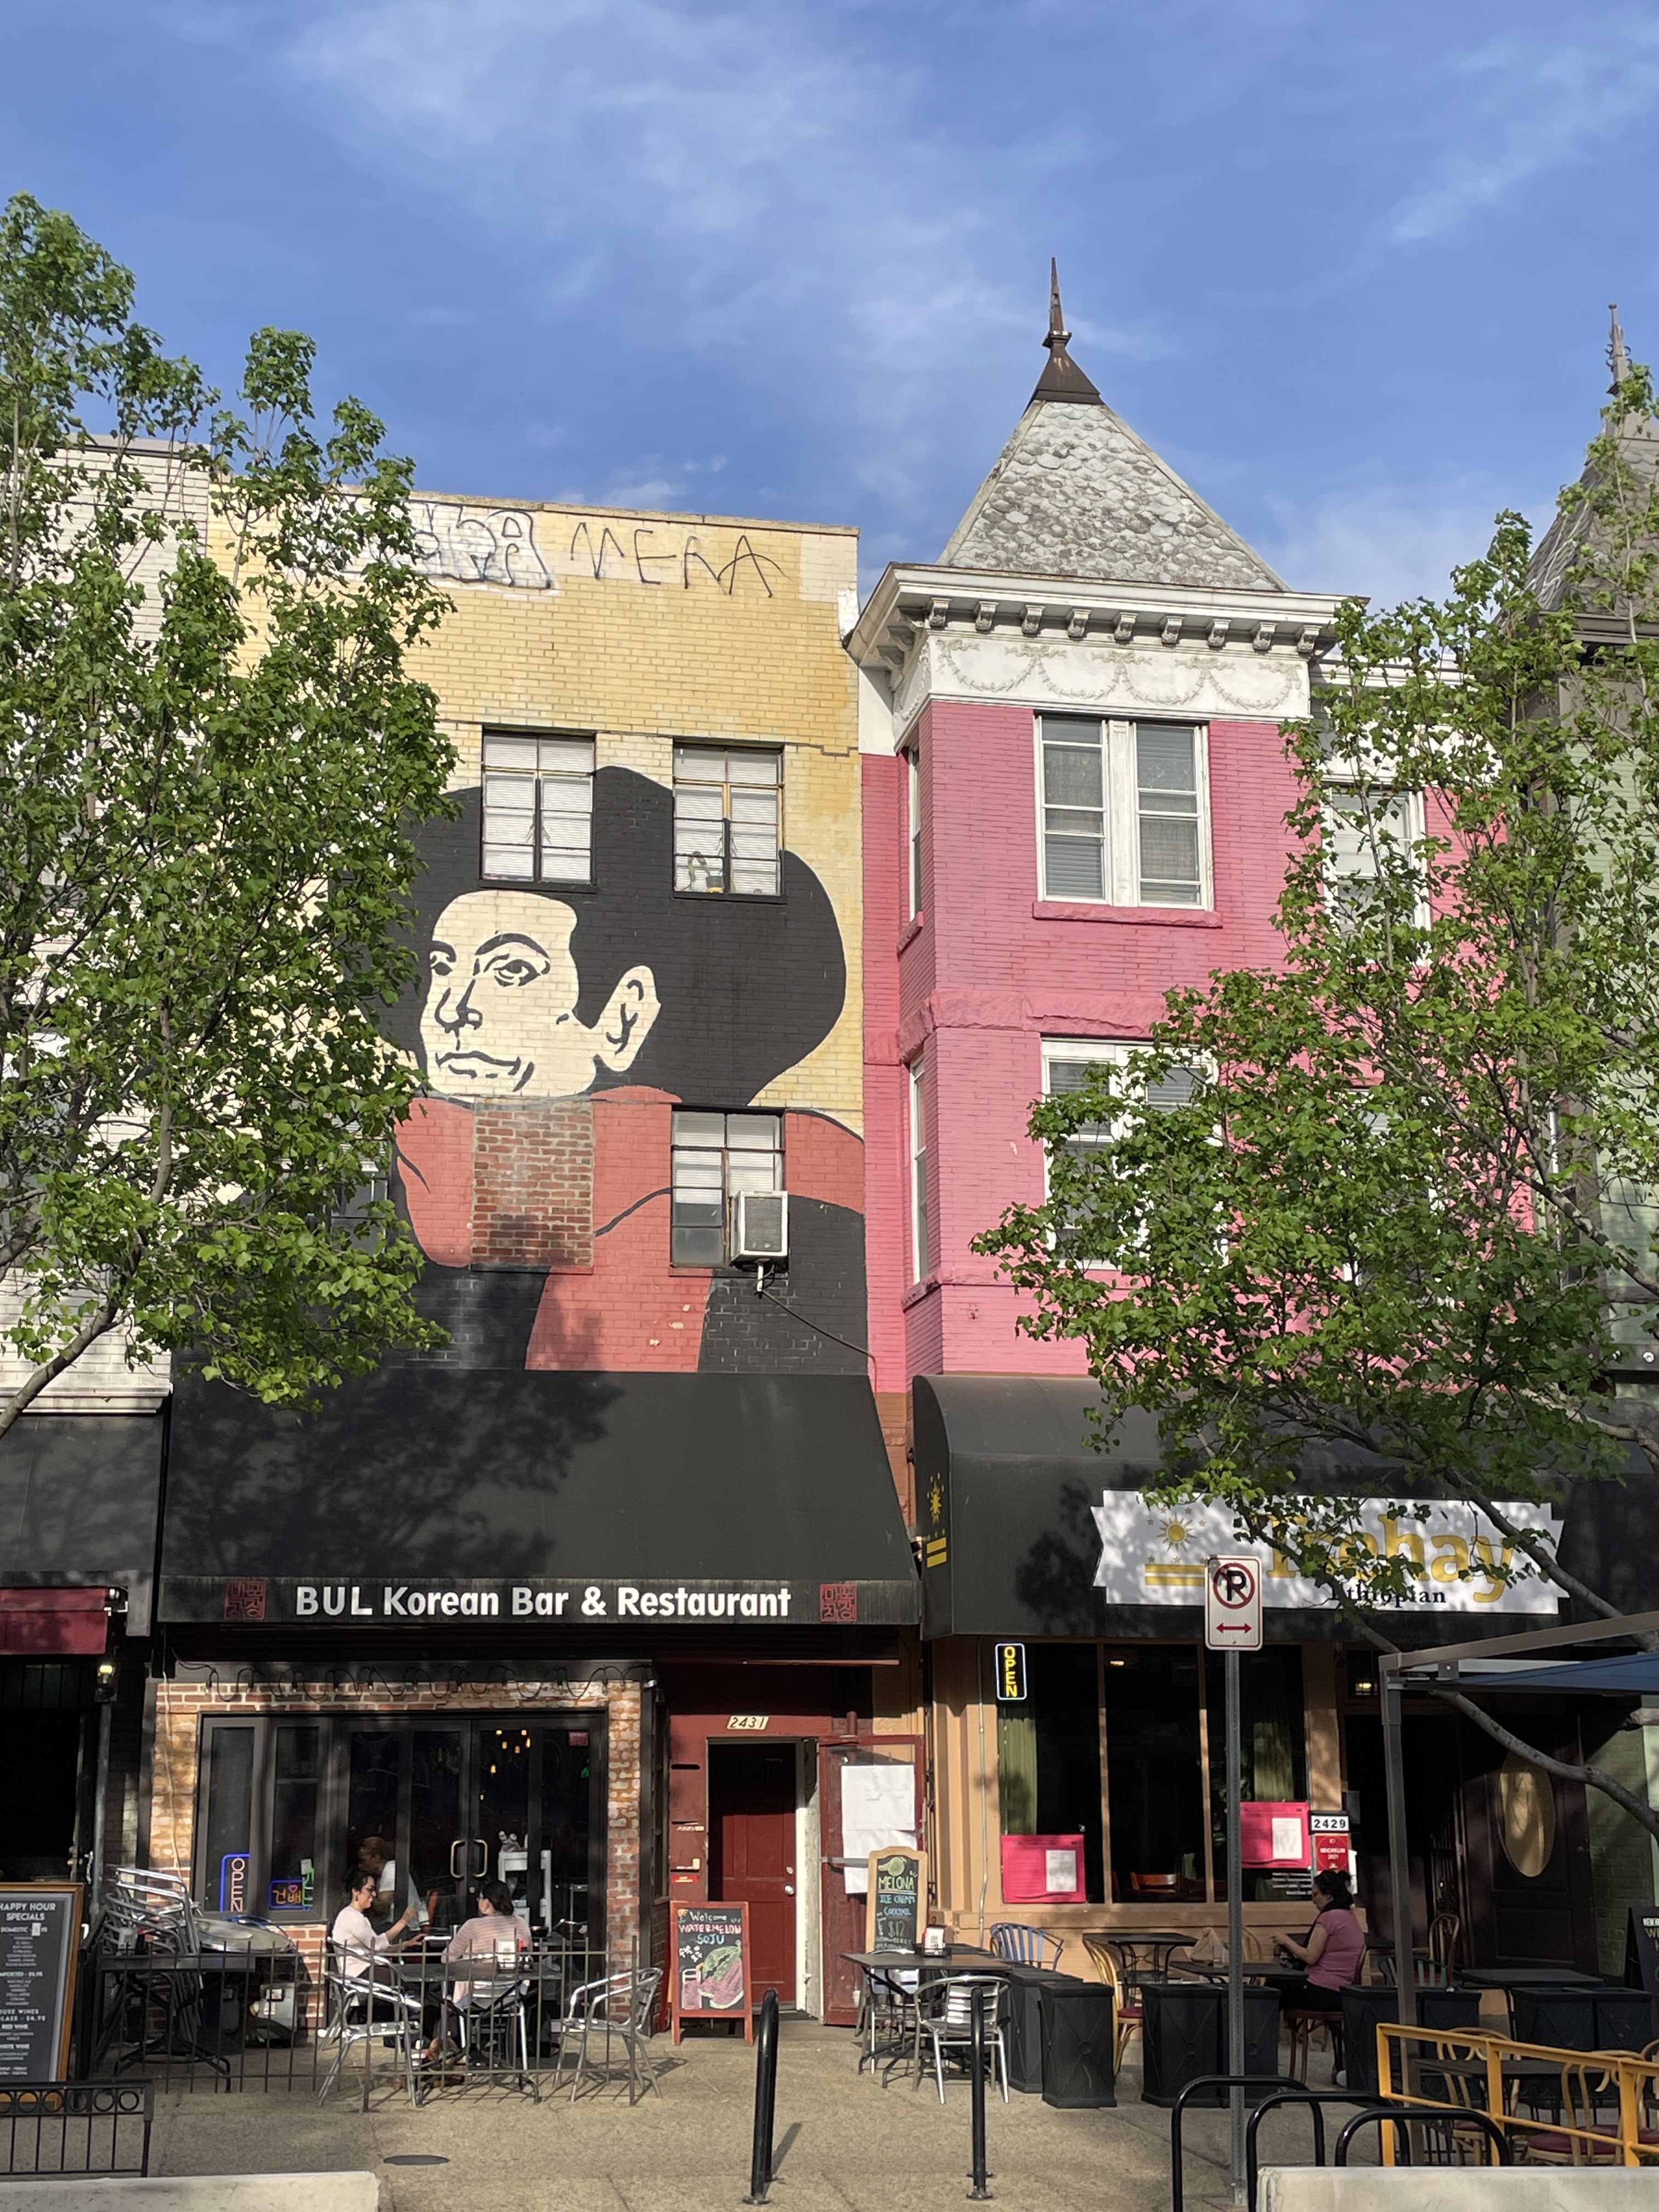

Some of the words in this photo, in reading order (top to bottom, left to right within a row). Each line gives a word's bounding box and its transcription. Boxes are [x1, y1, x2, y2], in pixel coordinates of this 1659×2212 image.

[296, 1586, 373, 1615] BUL
[383, 1586, 499, 1616] Korean
[512, 1587, 569, 1615] Bar
[581, 1586, 607, 1616] &
[618, 1587, 791, 1616] Restaurant
[1004, 1646, 1018, 1697] OPEN
[730, 1717, 765, 1729] 2431
[1313, 1819, 1346, 1829] 2429
[231, 1858, 245, 1912] OPEN
[878, 1875, 915, 1892] MELONA
[30, 1903, 55, 1911] HOUR
[6, 1912, 45, 1921] SPECIALS
[690, 1911, 727, 1921] Welcome
[678, 1923, 741, 1934] WATERMELON
[697, 1934, 725, 1944] SOJU
